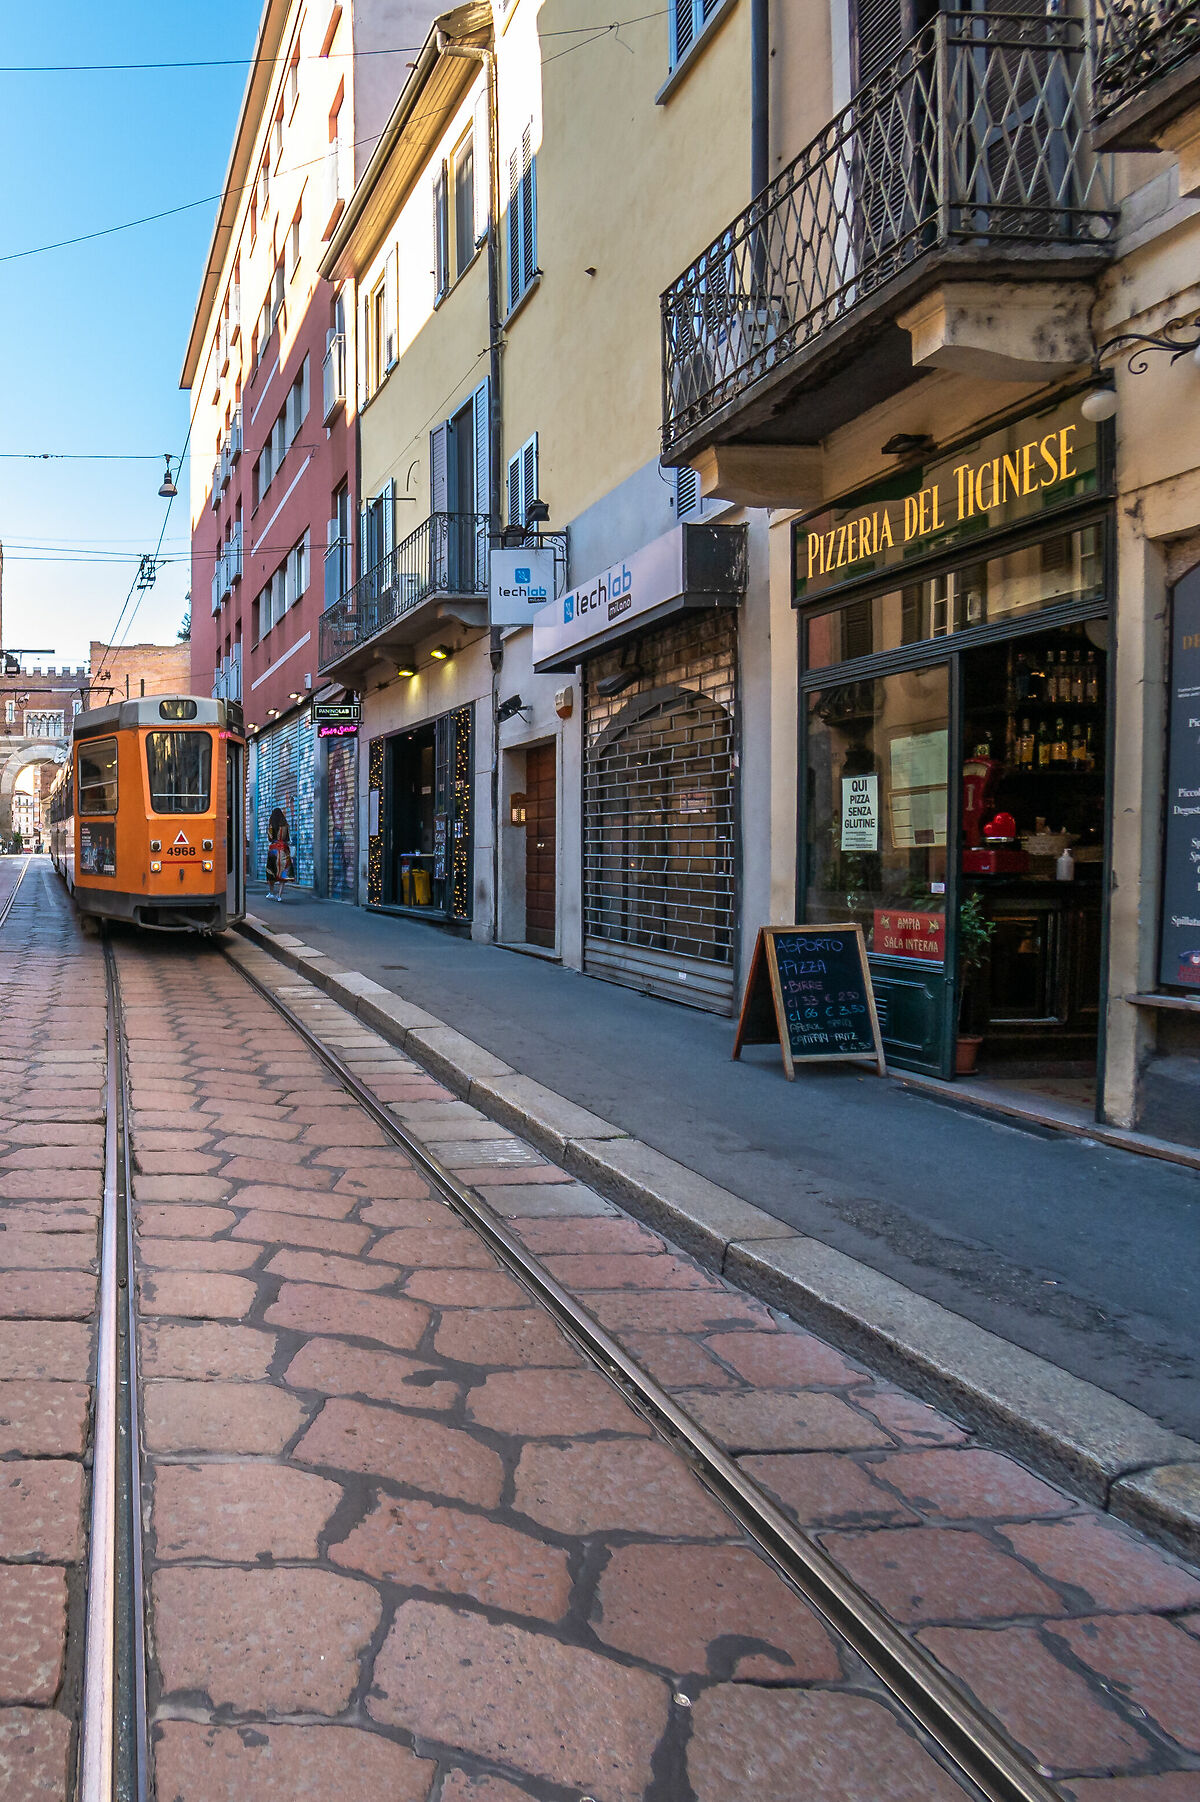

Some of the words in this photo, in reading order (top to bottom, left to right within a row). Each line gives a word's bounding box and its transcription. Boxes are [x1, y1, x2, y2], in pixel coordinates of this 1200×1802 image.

[807, 508, 894, 579] PIZZERIA
[904, 485, 944, 541] DEL
[953, 424, 1077, 521] TICINESE
[499, 586, 547, 597] techlab
[576, 564, 632, 617] techlab
[609, 598, 631, 617] milano
[852, 780, 867, 792] QUI
[850, 794, 870, 804] PIZZA
[848, 807, 872, 816] SENZA
[845, 819, 875, 828] GLUTINE
[166, 846, 196, 856] 4968
[897, 918, 920, 930] AMPIA
[777, 938, 843, 953] ASPORTO
[884, 936, 903, 949] SALA
[906, 939, 938, 952] INTERNA
[804, 1008, 818, 1018] 66
